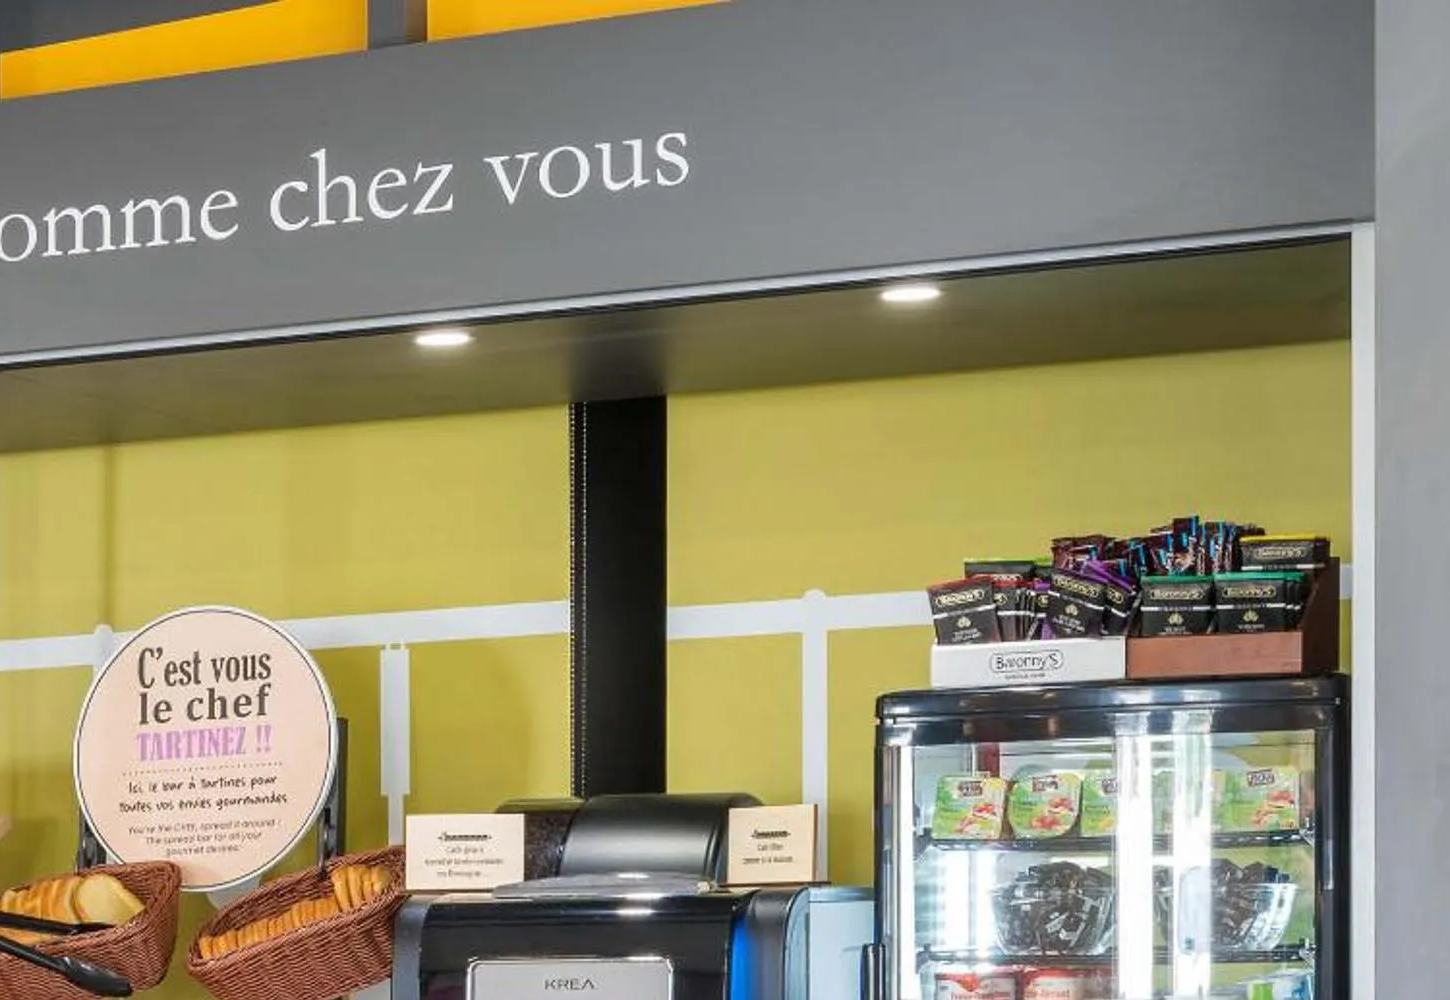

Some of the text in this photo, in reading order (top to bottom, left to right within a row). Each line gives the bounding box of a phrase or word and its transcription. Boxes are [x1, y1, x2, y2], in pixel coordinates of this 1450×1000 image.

[270, 148, 453, 231] chez
[484, 133, 689, 204] vous
[137, 647, 272, 689] C'est vous
[139, 683, 272, 725] le chef
[136, 724, 273, 763] TARTINEZ !!
[250, 775, 278, 790] pour
[156, 799, 175, 811] vos
[544, 979, 596, 991] KREA
